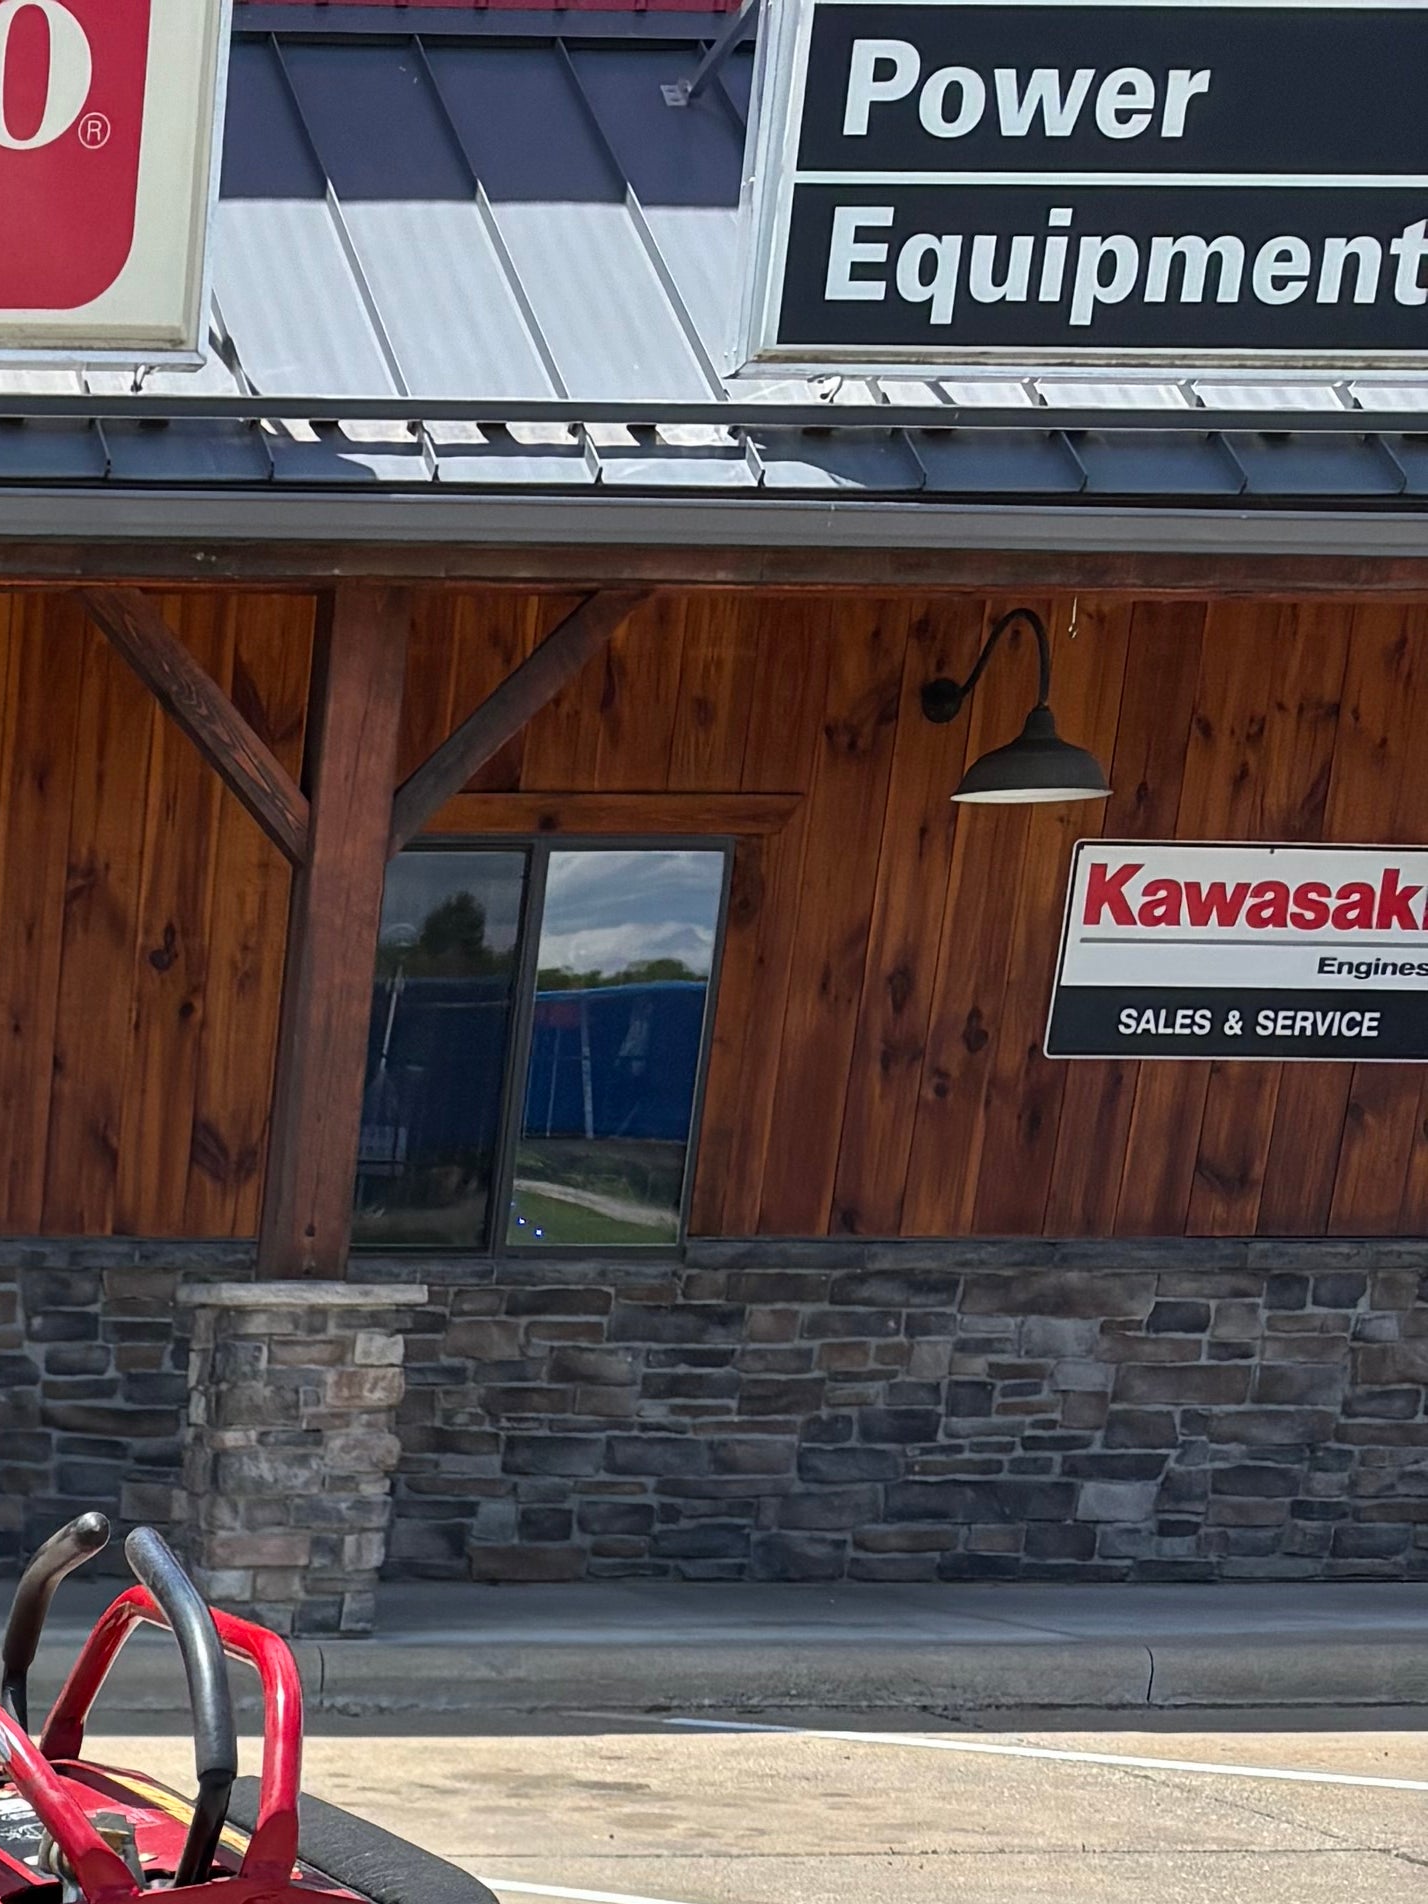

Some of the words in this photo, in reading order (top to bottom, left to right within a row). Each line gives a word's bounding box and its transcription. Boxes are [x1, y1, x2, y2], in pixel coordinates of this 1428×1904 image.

[842, 38, 1211, 139] Power
[824, 206, 1428, 326] Equipment
[1317, 956, 1428, 980] Engines
[1118, 1008, 1212, 1036] SALES
[1223, 1010, 1243, 1036] &
[1255, 1010, 1381, 1038] SERVICE
